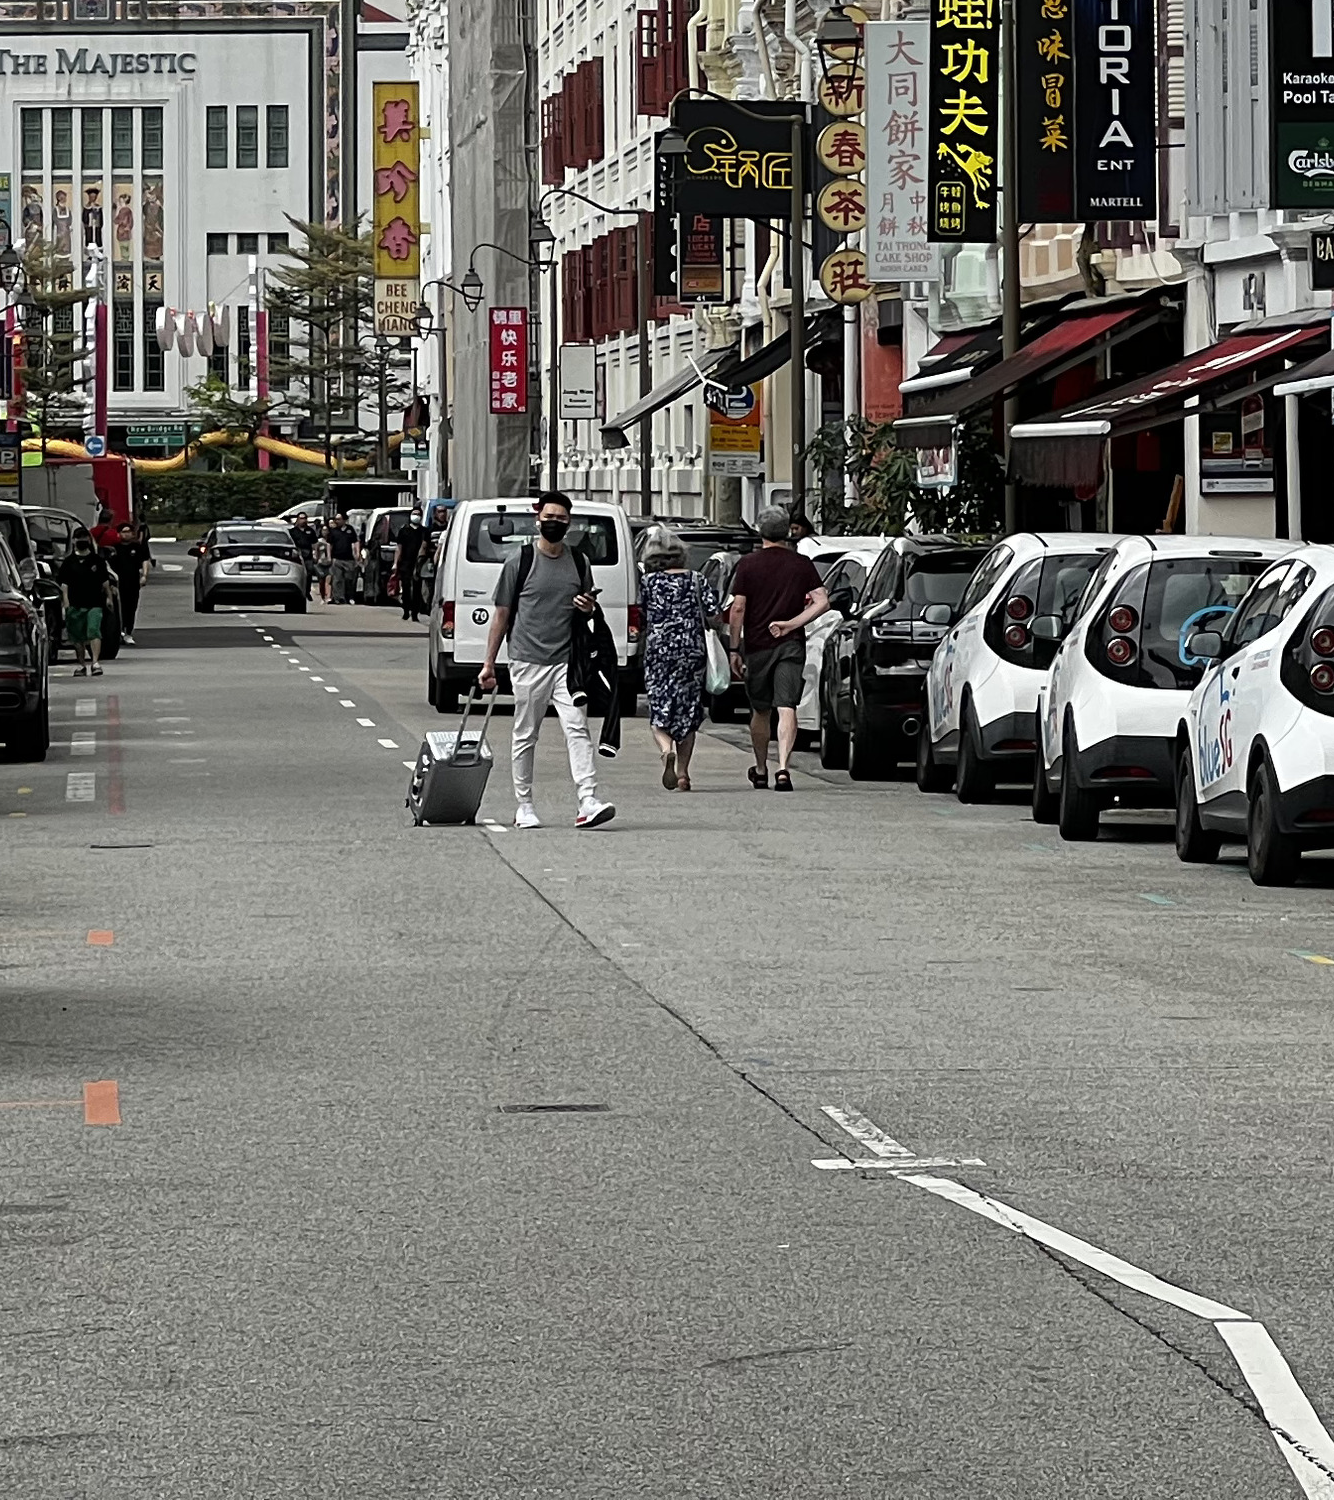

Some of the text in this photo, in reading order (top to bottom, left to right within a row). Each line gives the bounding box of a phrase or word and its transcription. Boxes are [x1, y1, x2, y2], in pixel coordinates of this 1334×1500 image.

[1283, 91, 1317, 104] Pool
[824, 22, 868, 294] 新春茶莊
[1097, 159, 1135, 171] ENT
[1089, 197, 1144, 207] MARTELL
[905, 253, 932, 263] SHOP
[386, 284, 408, 297] BEE
[377, 301, 417, 314] CHENG
[474, 611, 487, 620] 70
